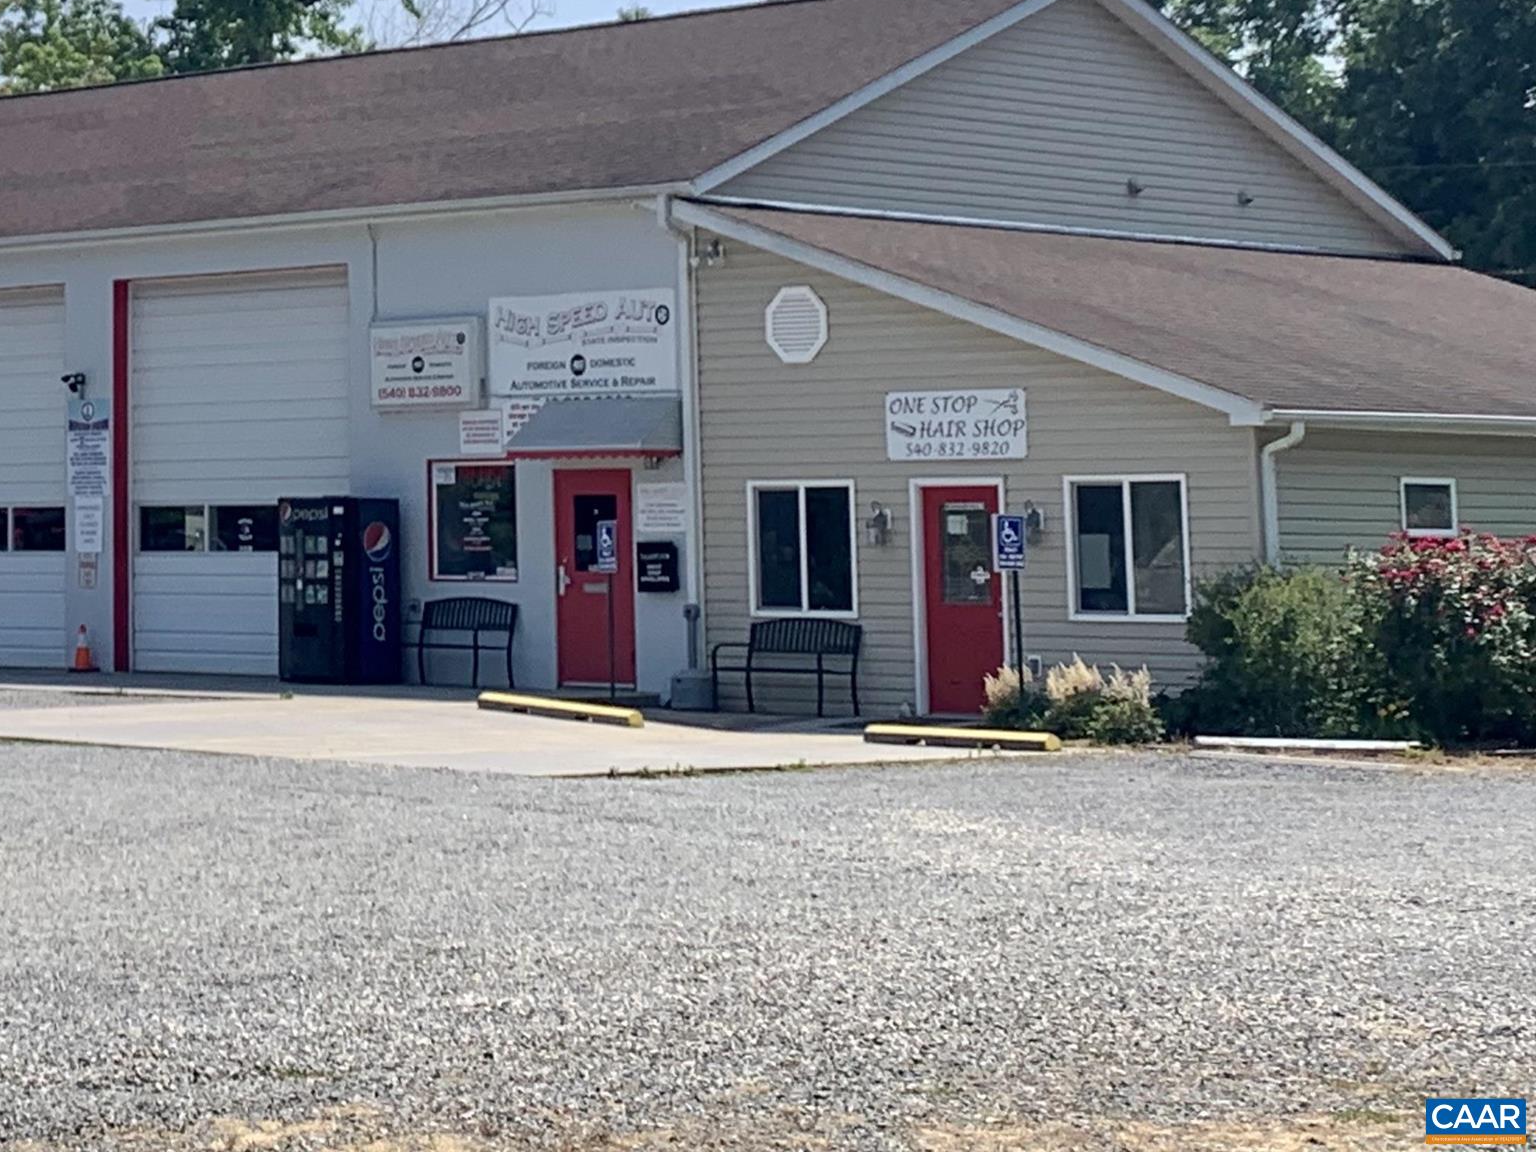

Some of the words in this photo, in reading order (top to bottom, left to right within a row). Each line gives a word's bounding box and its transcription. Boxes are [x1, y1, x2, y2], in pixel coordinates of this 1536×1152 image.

[495, 305, 540, 337] HIGH
[546, 301, 608, 335] SPEED
[526, 360, 567, 371] FOREIGN
[590, 358, 636, 368] DOMESTIC
[510, 377, 567, 391] AUTOMOTIVE
[570, 376, 609, 389] SERVICE
[620, 375, 657, 387] REPAIR
[889, 396, 926, 415] ONE
[930, 395, 978, 415] STOP
[920, 419, 967, 439] HAIR
[972, 418, 1025, 438] SHOP
[292, 506, 329, 521] pepsi
[369, 567, 389, 642] pepsi
